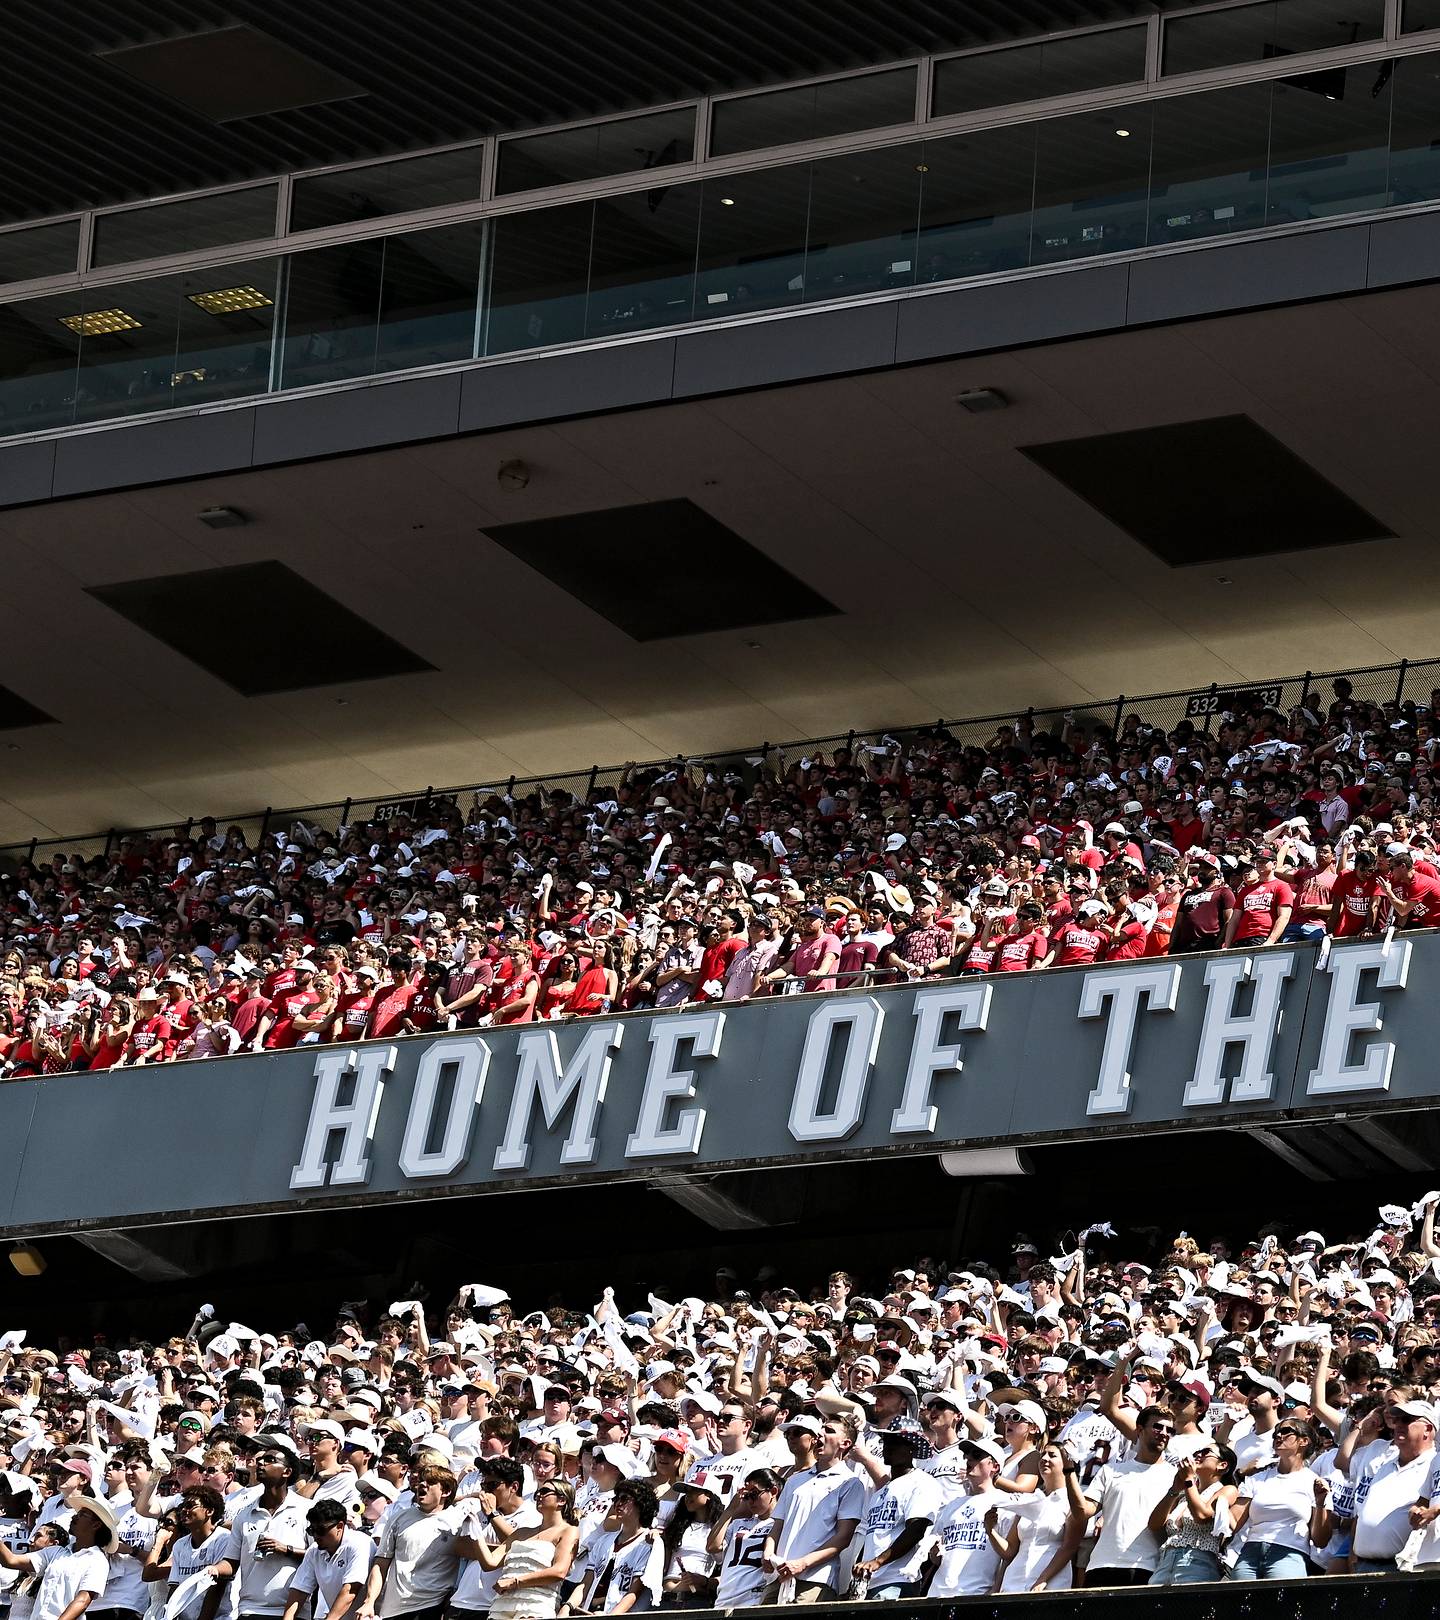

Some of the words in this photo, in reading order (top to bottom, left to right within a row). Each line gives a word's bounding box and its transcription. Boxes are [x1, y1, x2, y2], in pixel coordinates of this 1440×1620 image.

[1190, 696, 1219, 715] 332
[289, 1011, 726, 1189] HOME
[787, 983, 994, 1144] OF
[1077, 939, 1414, 1117] THE
[695, 1464, 723, 1473] TEXAS
